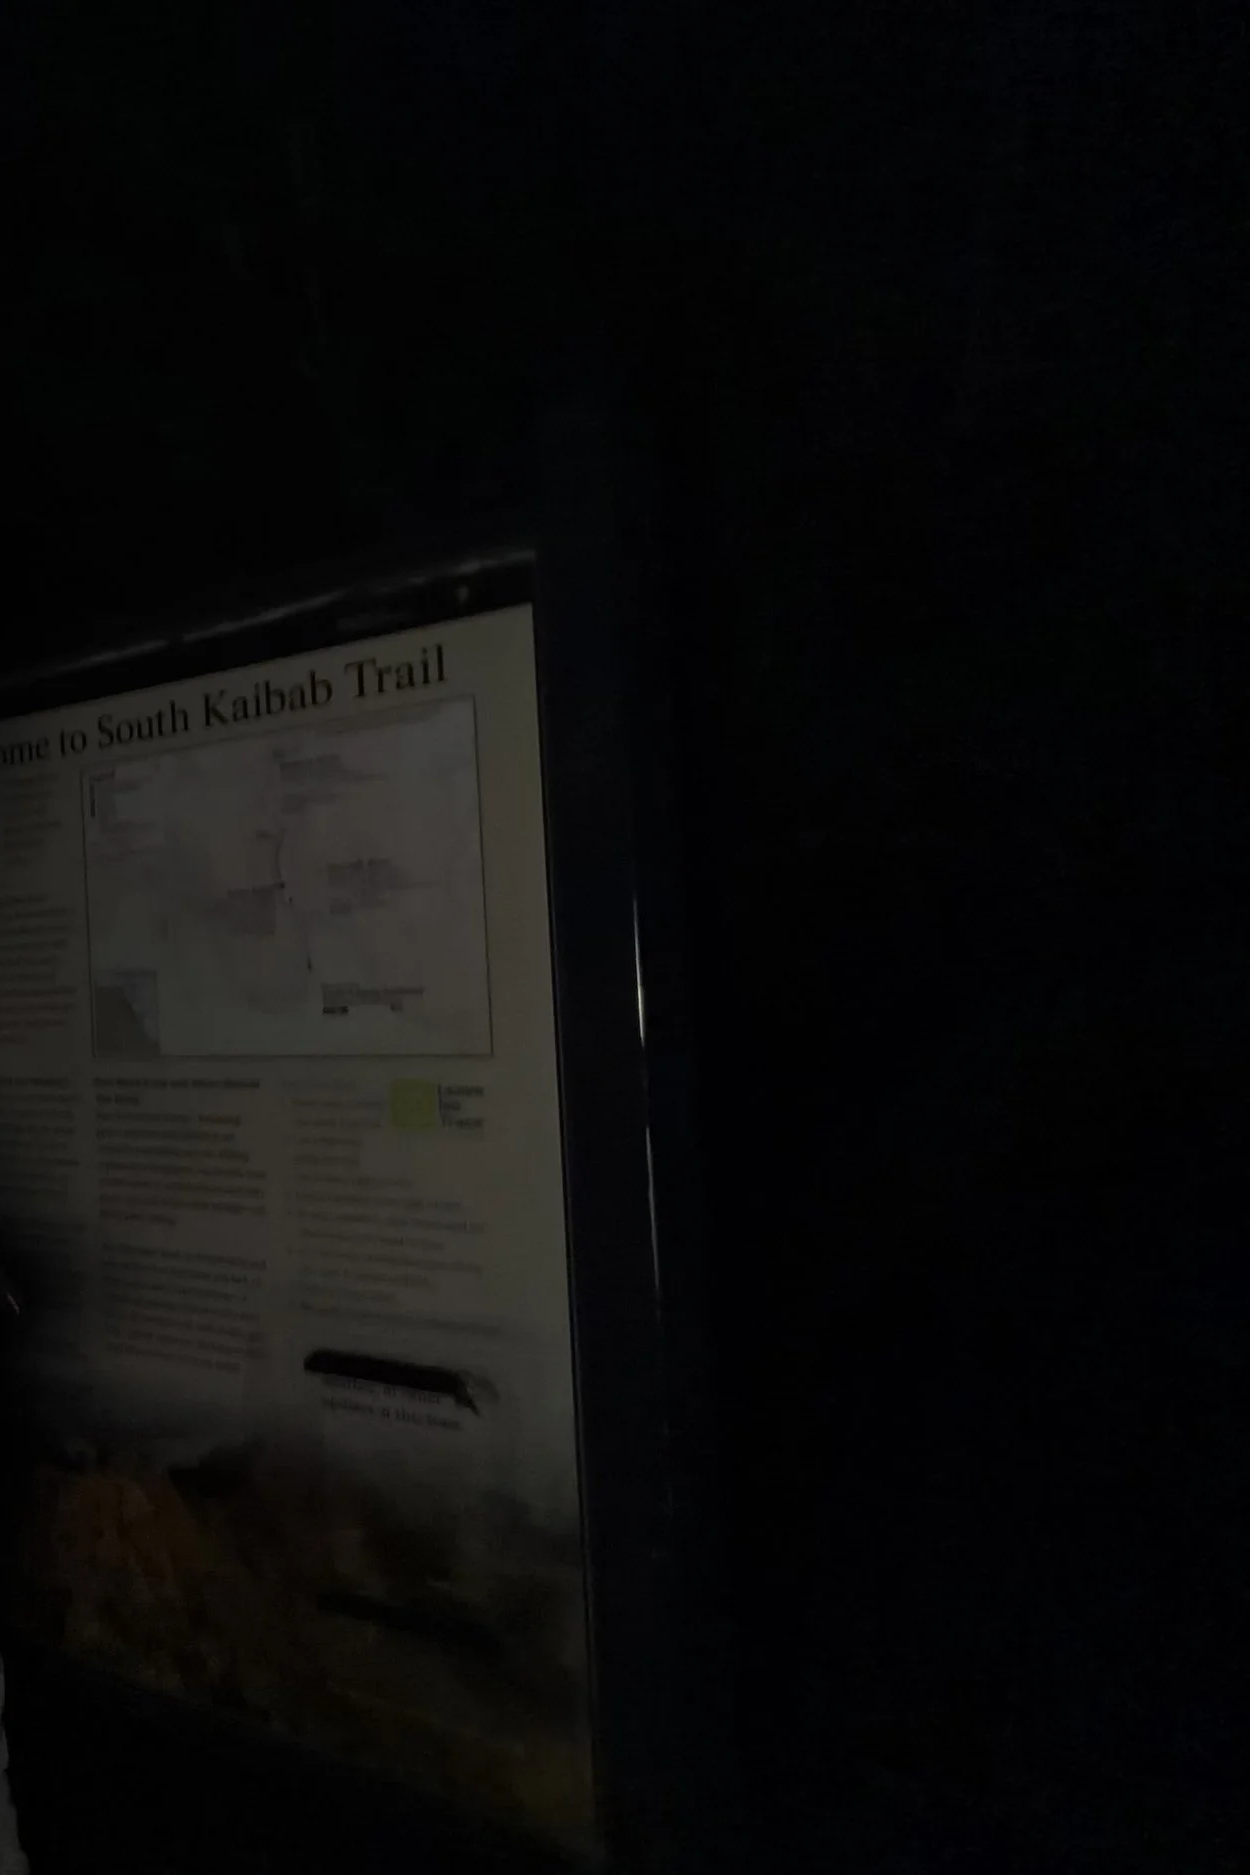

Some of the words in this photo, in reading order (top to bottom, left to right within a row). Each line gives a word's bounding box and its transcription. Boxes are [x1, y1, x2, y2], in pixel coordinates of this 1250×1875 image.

[59, 729, 87, 757] to
[98, 700, 190, 750] South
[203, 669, 333, 727] Kaibab
[344, 643, 446, 697] Trail
